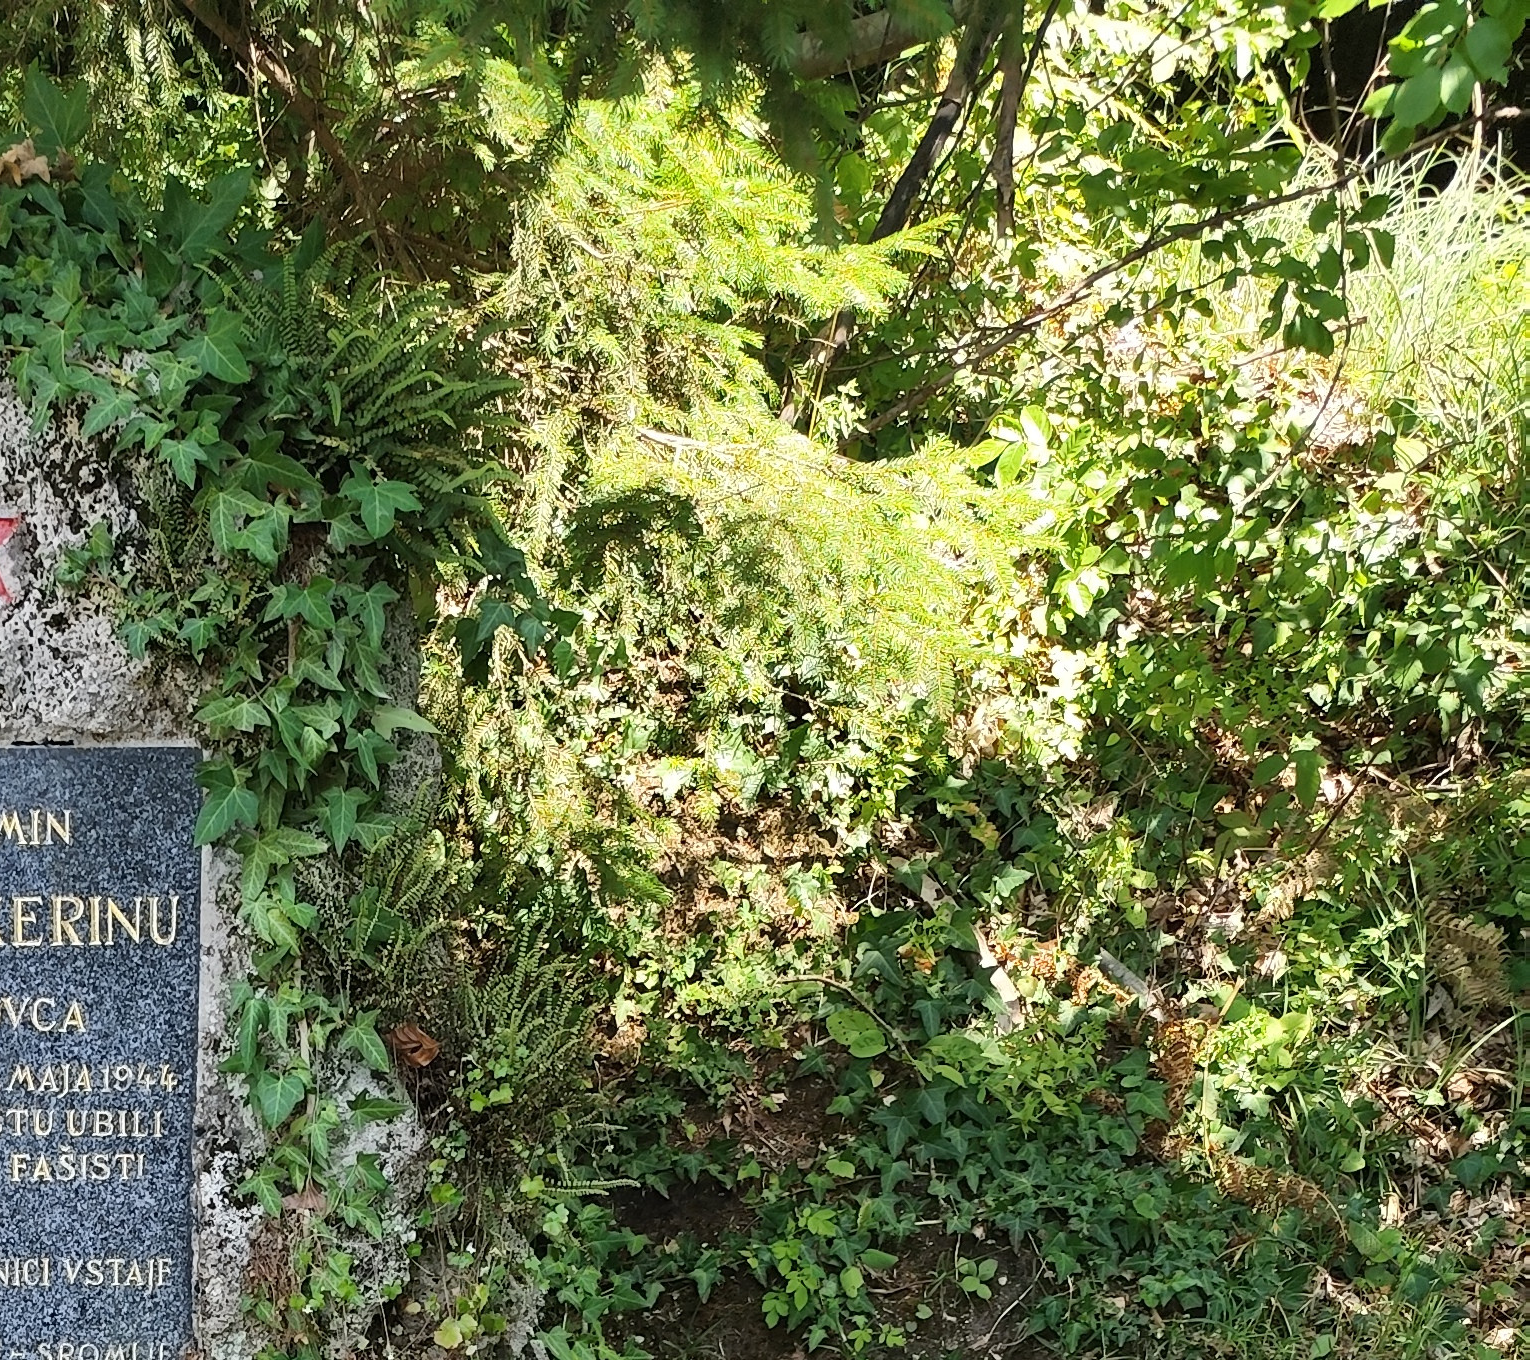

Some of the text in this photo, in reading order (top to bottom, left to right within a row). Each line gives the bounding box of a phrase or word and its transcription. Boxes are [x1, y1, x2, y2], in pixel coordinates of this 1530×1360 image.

[100, 1062, 178, 1093] 1944
[66, 1109, 163, 1138] UBILI
[11, 1144, 147, 1183] FAŠISTI
